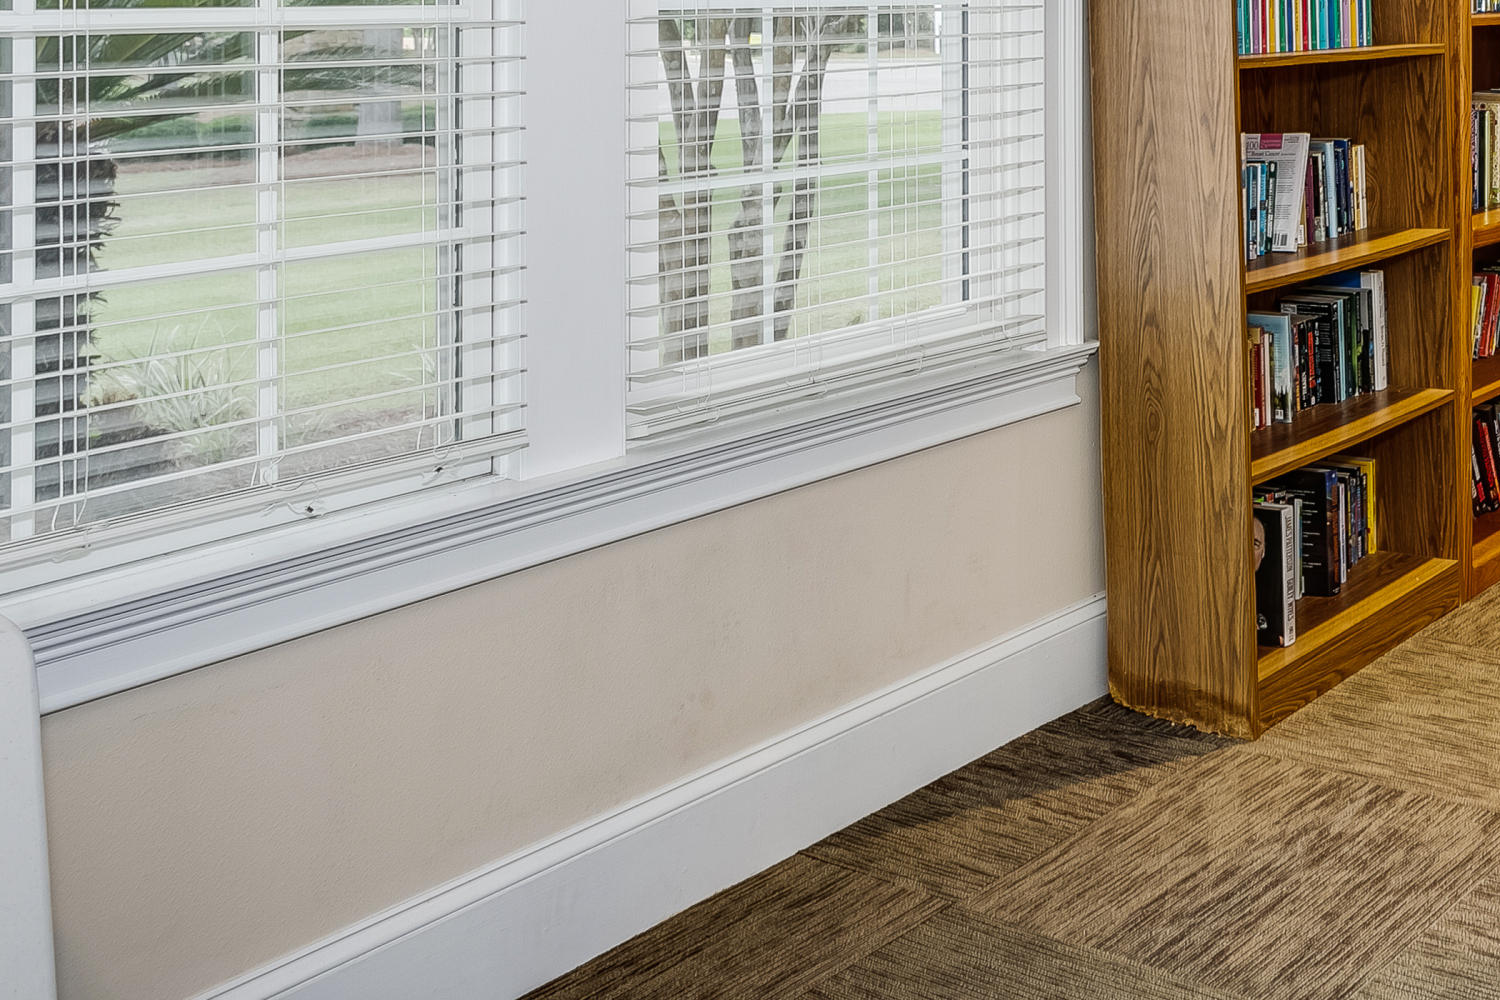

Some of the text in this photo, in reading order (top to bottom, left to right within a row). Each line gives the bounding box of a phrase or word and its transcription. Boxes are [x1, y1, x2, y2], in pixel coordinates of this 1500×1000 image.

[1285, 515, 1295, 537] JAMES
[1285, 538, 1295, 572] PATTERSON
[1285, 603, 1295, 621] WIVES
